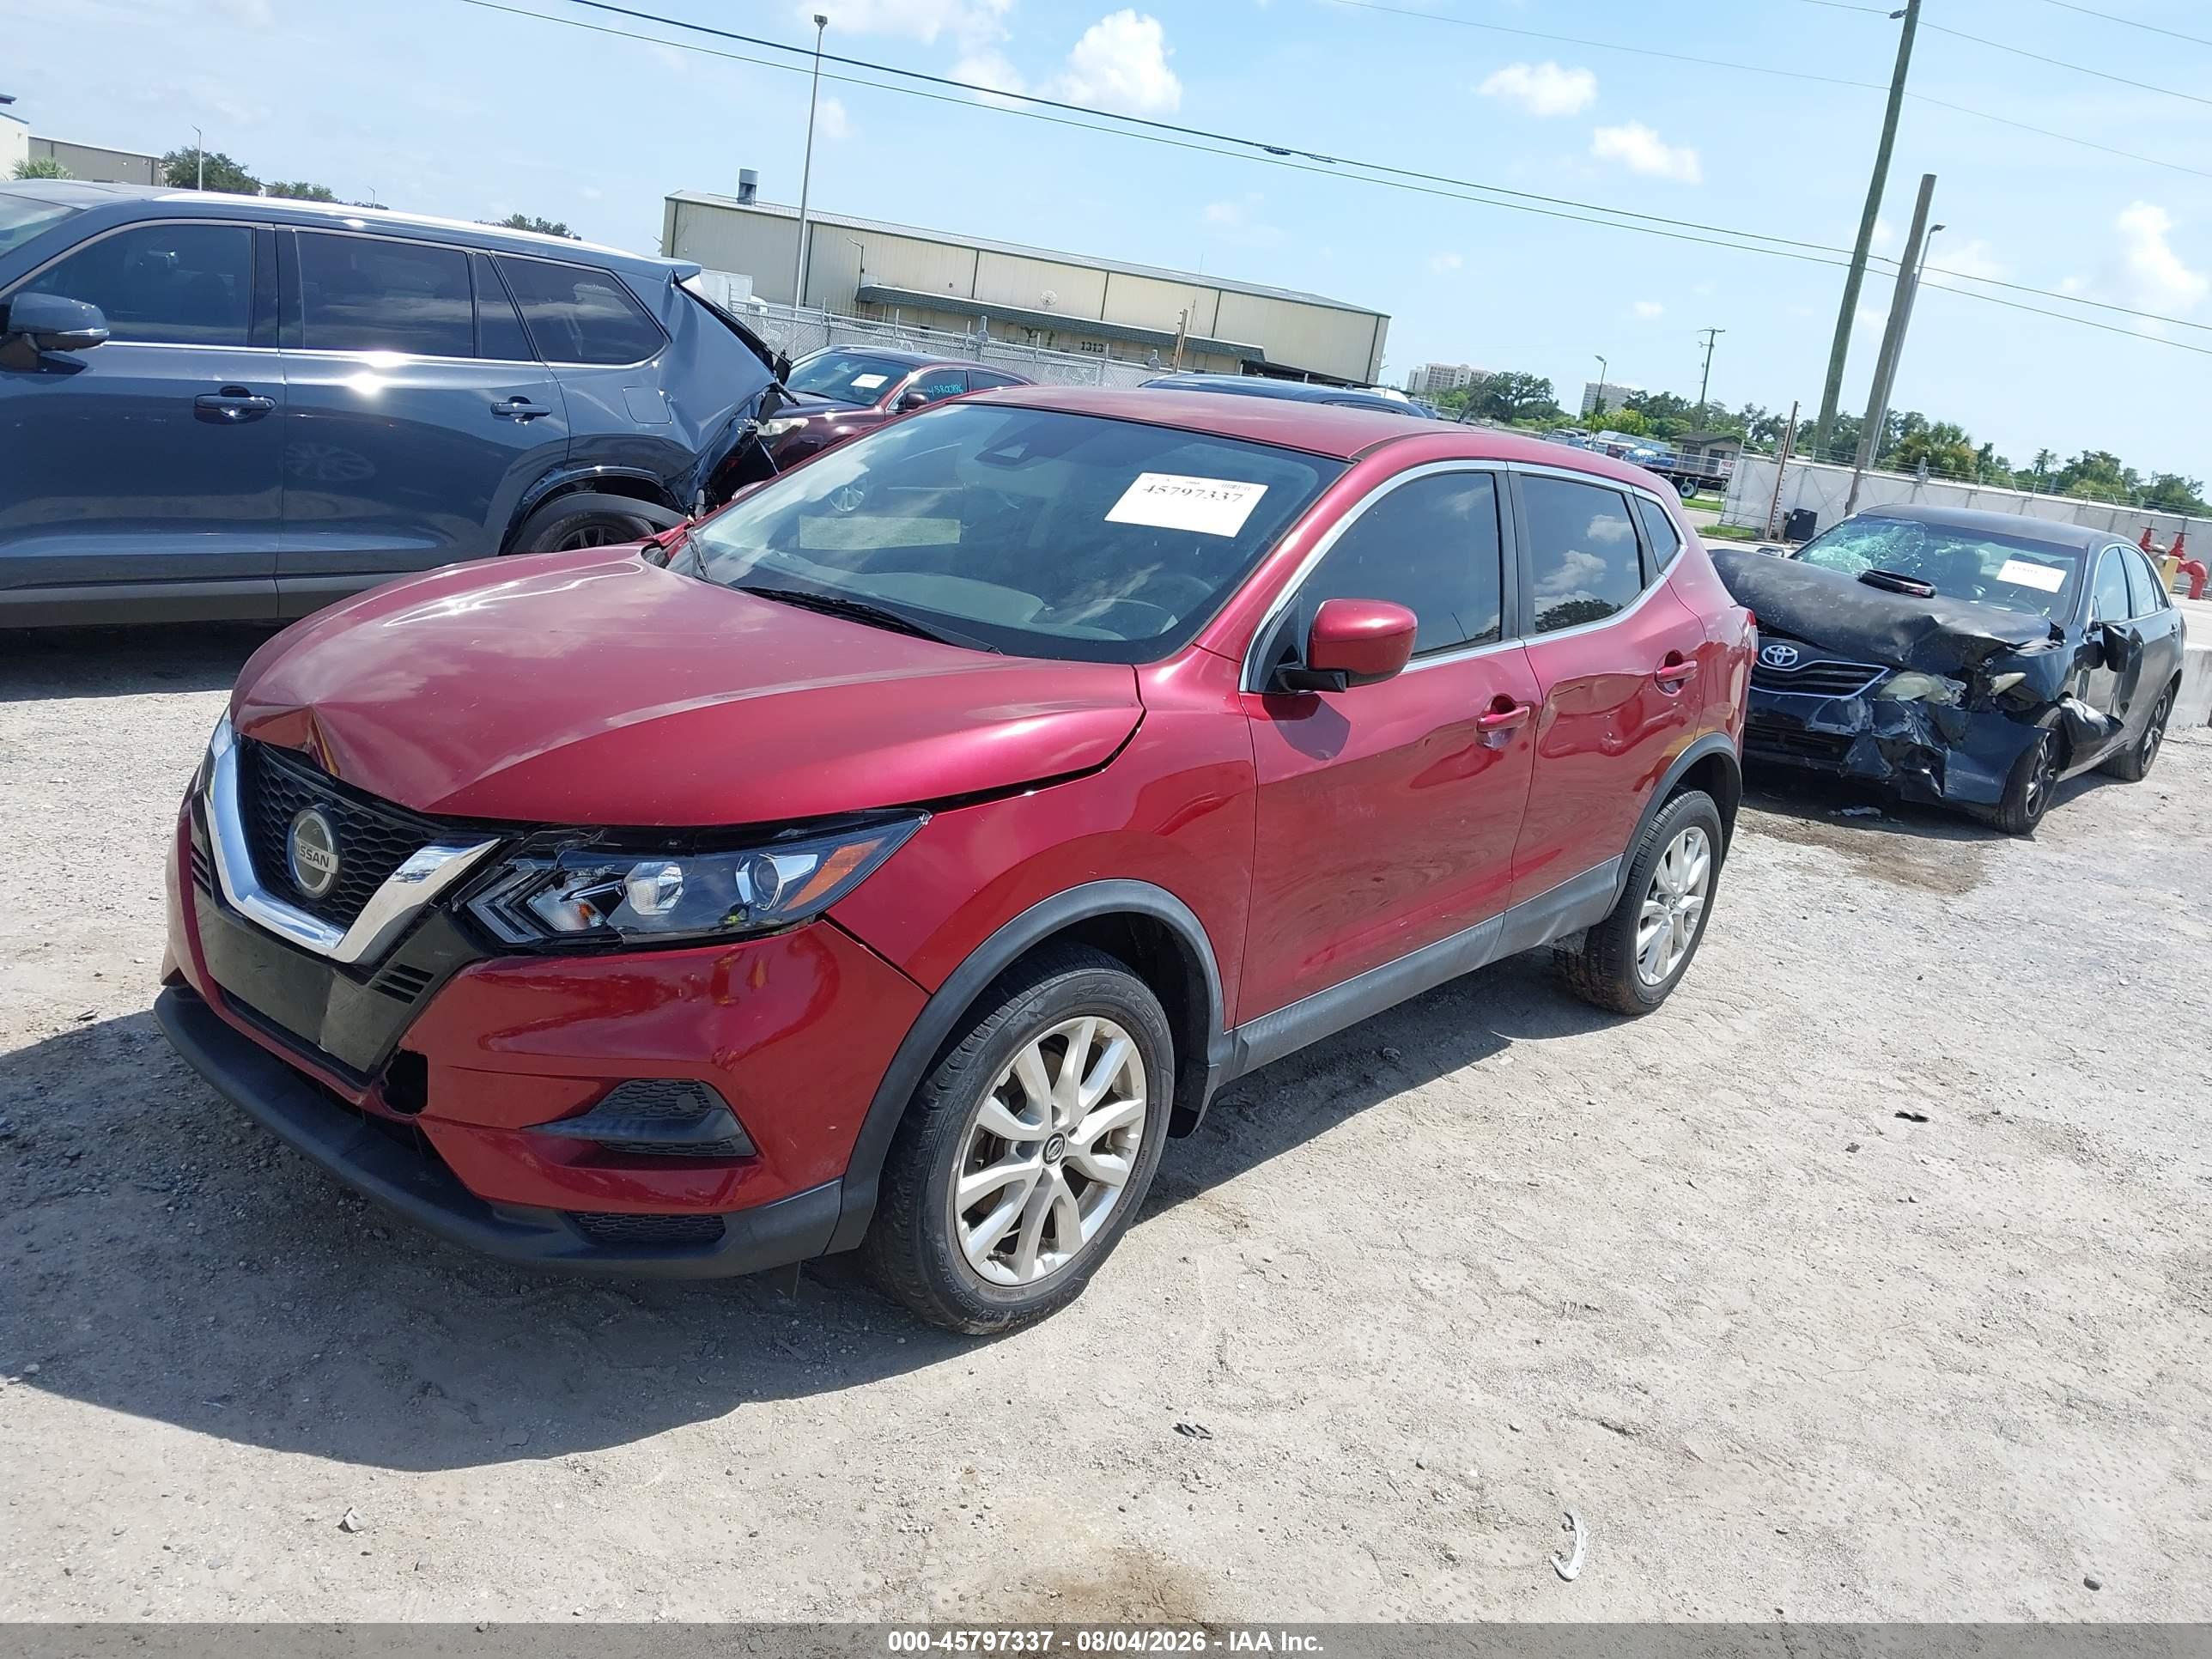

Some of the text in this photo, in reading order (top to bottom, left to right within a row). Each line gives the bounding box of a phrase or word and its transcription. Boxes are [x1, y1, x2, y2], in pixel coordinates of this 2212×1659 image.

[1080, 341, 1104, 353] 1313
[1141, 484, 1244, 502] 45797337
[295, 843, 330, 868] ISSAN
